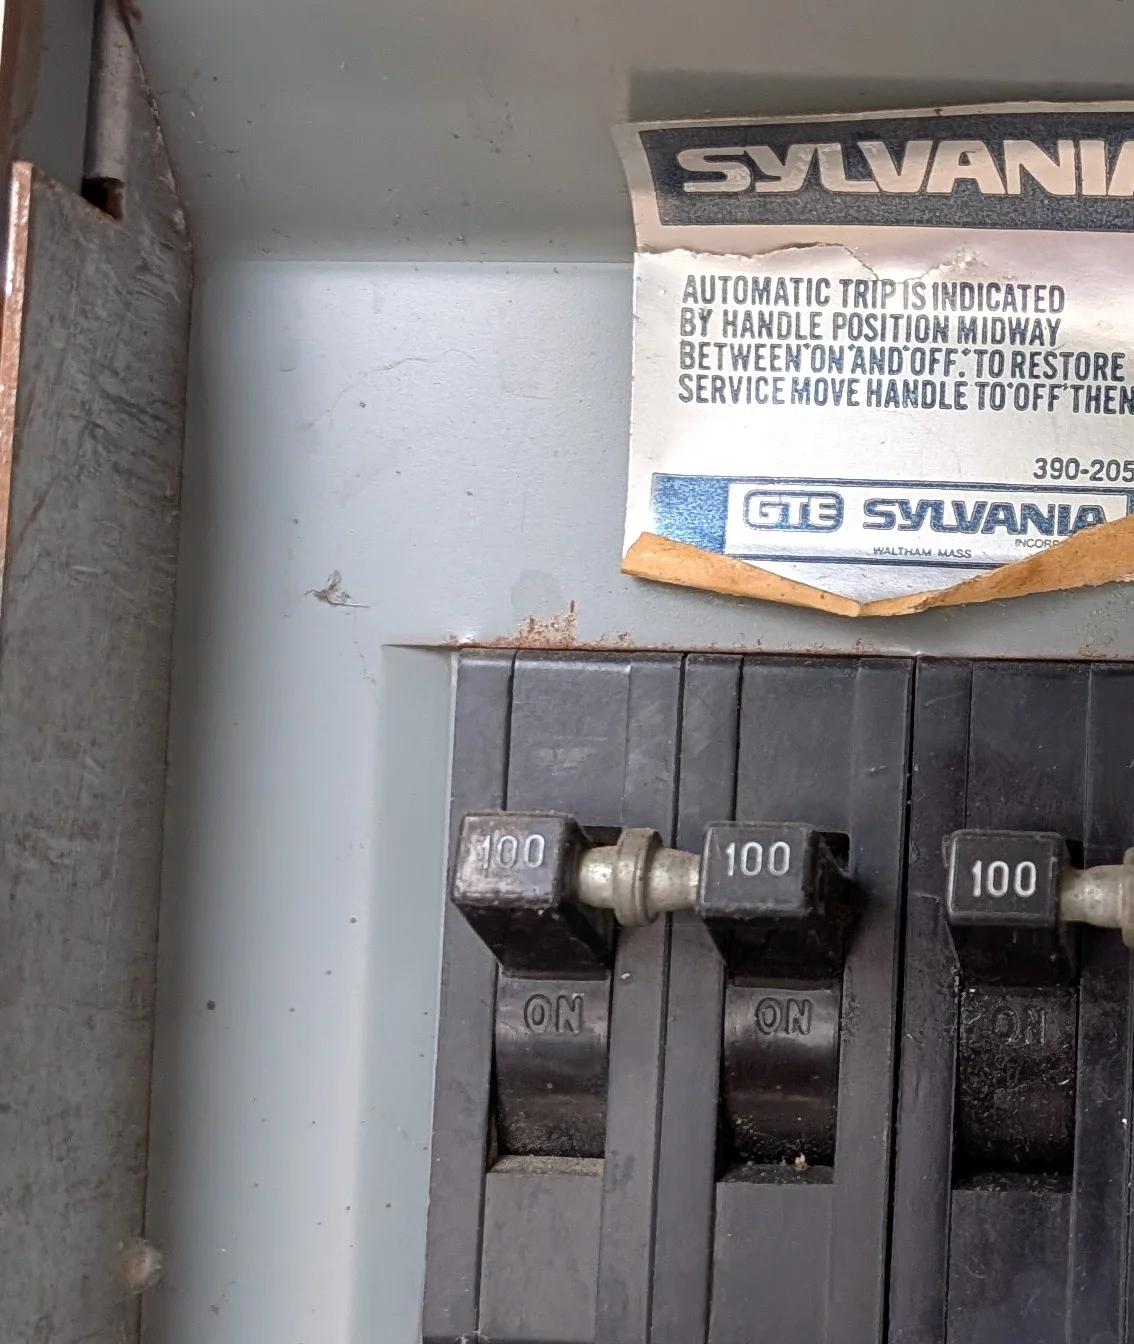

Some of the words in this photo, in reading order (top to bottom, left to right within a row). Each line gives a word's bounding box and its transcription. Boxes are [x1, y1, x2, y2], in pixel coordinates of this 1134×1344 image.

[682, 275, 831, 306] AUTOMATIC
[838, 278, 896, 309] TRIP
[902, 281, 927, 310] IS
[931, 281, 1066, 314] INDICATED
[679, 307, 713, 338] BY
[722, 309, 823, 340] HANDLE
[832, 312, 950, 343] POSITION
[957, 315, 1062, 347] MIDWAY
[679, 340, 801, 372] BETWEEN
[851, 345, 903, 375] AND
[973, 348, 1005, 379] TO
[1010, 350, 1126, 382] RESTORE
[678, 373, 785, 404] SERVICE
[790, 376, 860, 407] MOVE
[866, 378, 969, 410] HANDLE
[974, 381, 1007, 411] TO
[743, 489, 845, 533] GTE
[862, 498, 1108, 536] SYLVANIA
[873, 546, 933, 557] WALTHAM
[937, 548, 973, 560] MASS
[480, 834, 546, 870] 100
[725, 840, 791, 877] 100
[971, 859, 1038, 898] 100
[523, 992, 584, 1034] ON
[753, 995, 813, 1036] ON
